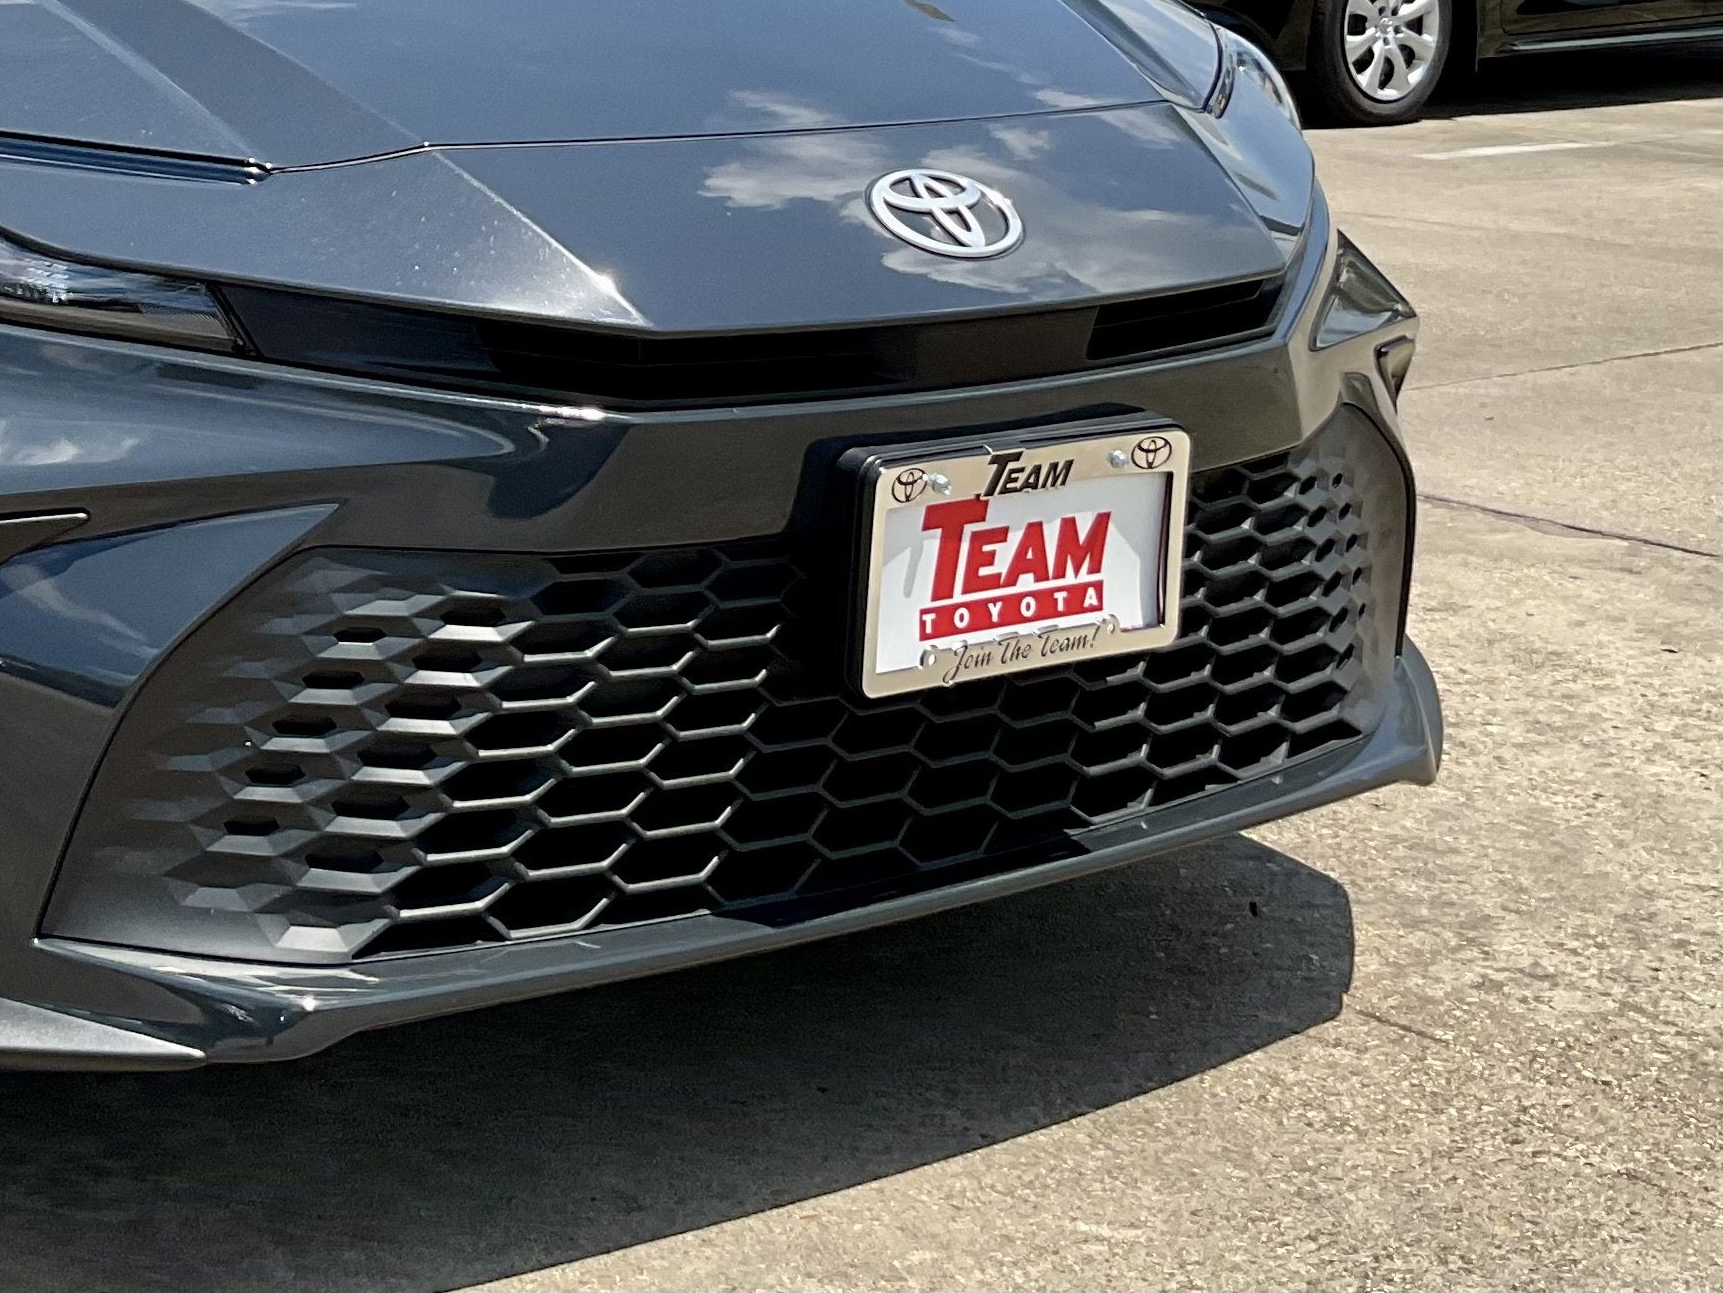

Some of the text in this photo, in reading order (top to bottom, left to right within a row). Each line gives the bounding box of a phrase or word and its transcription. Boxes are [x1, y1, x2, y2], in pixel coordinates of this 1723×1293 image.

[982, 450, 1075, 496] TEAM
[921, 497, 1112, 602] TEAM
[921, 587, 1099, 635] TOYOTA
[942, 626, 1100, 685] Join The Team!
